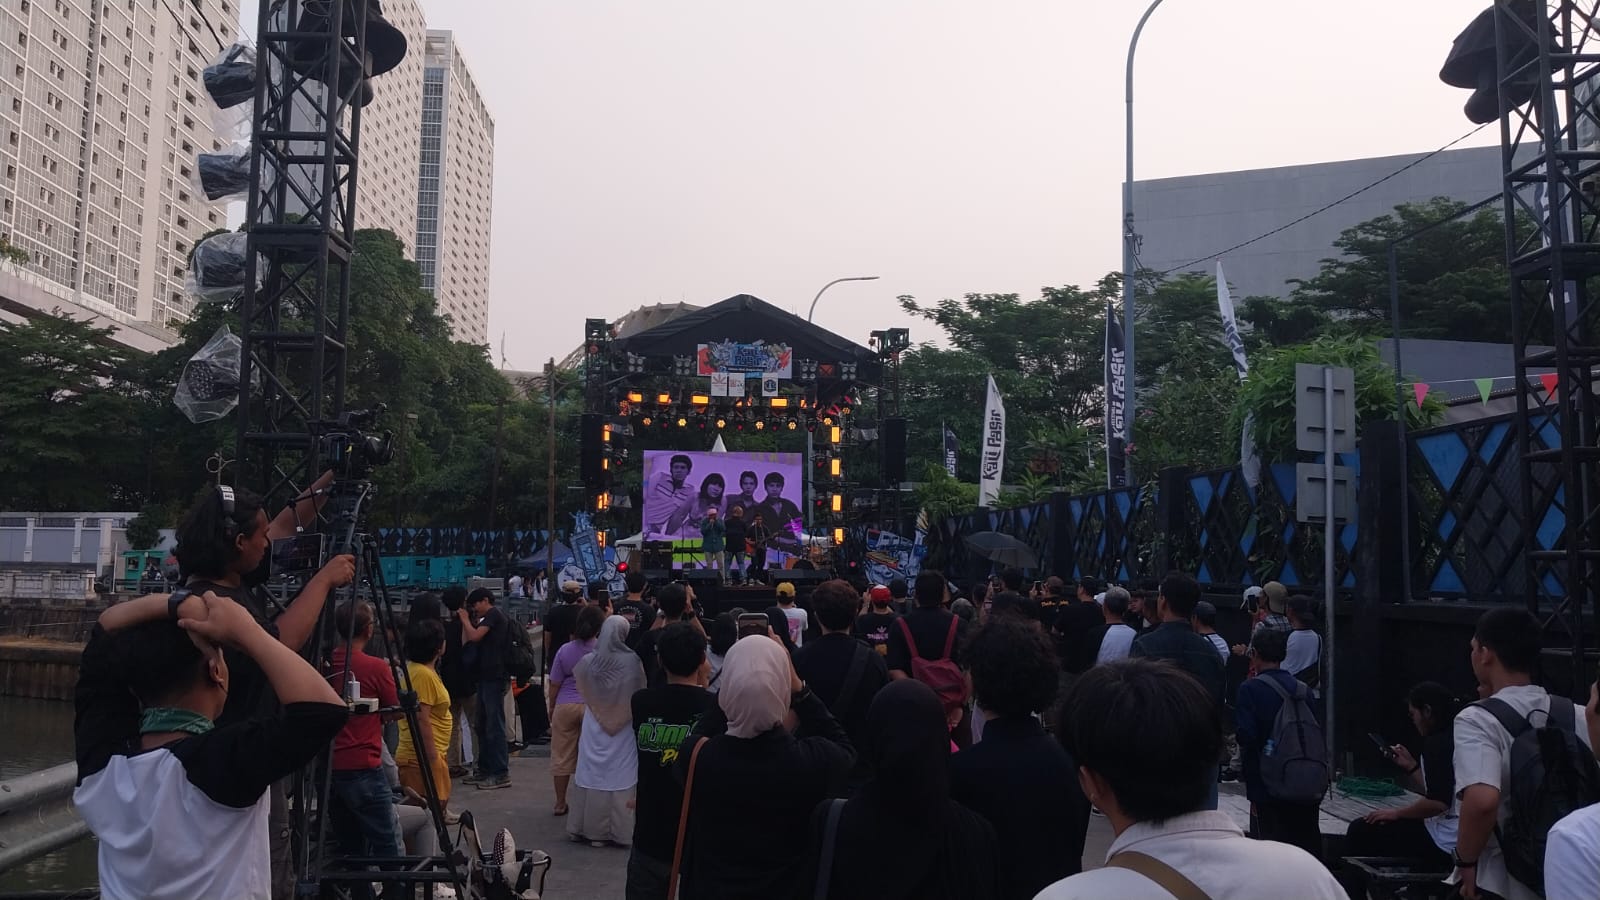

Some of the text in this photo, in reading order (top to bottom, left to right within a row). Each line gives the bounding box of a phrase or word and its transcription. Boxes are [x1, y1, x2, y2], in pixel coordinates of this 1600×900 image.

[1110, 347, 1126, 399] Pasir
[982, 409, 1003, 481] Kali Pasir
